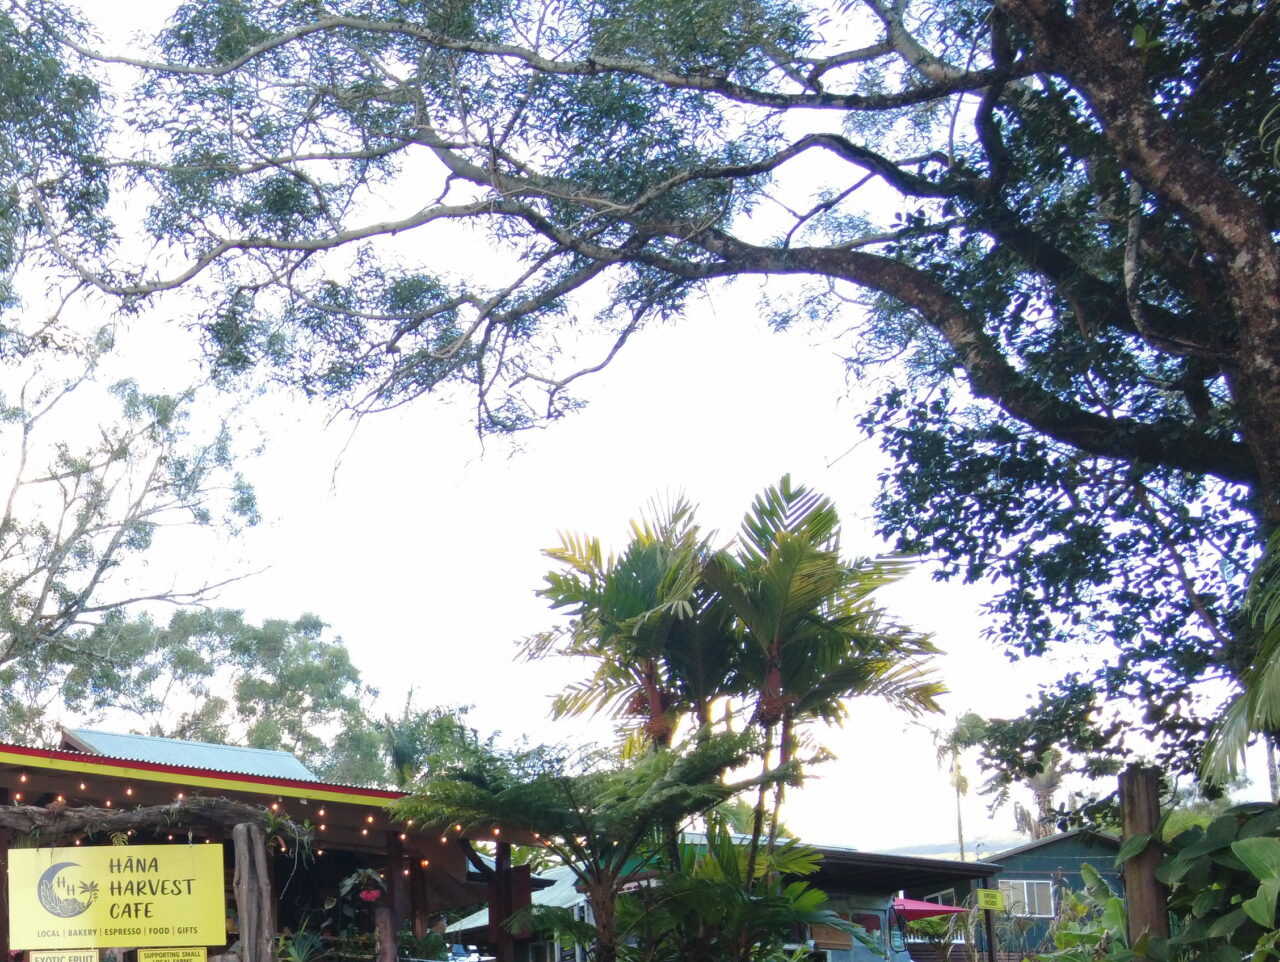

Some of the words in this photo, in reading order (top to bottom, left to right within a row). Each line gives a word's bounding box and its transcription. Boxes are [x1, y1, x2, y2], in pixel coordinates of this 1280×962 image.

[109, 855, 160, 874] HĀNA
[109, 878, 197, 897] HARVEST
[109, 902, 154, 919] CAFE
[37, 929, 60, 938] LOCAL
[68, 928, 98, 937] BAKERY
[104, 927, 142, 937] ESPRESSO
[148, 927, 170, 936] FOOD
[177, 926, 198, 935] GIFTS
[143, 951, 180, 959] SUPPORTING
[181, 950, 202, 958] SMALL
